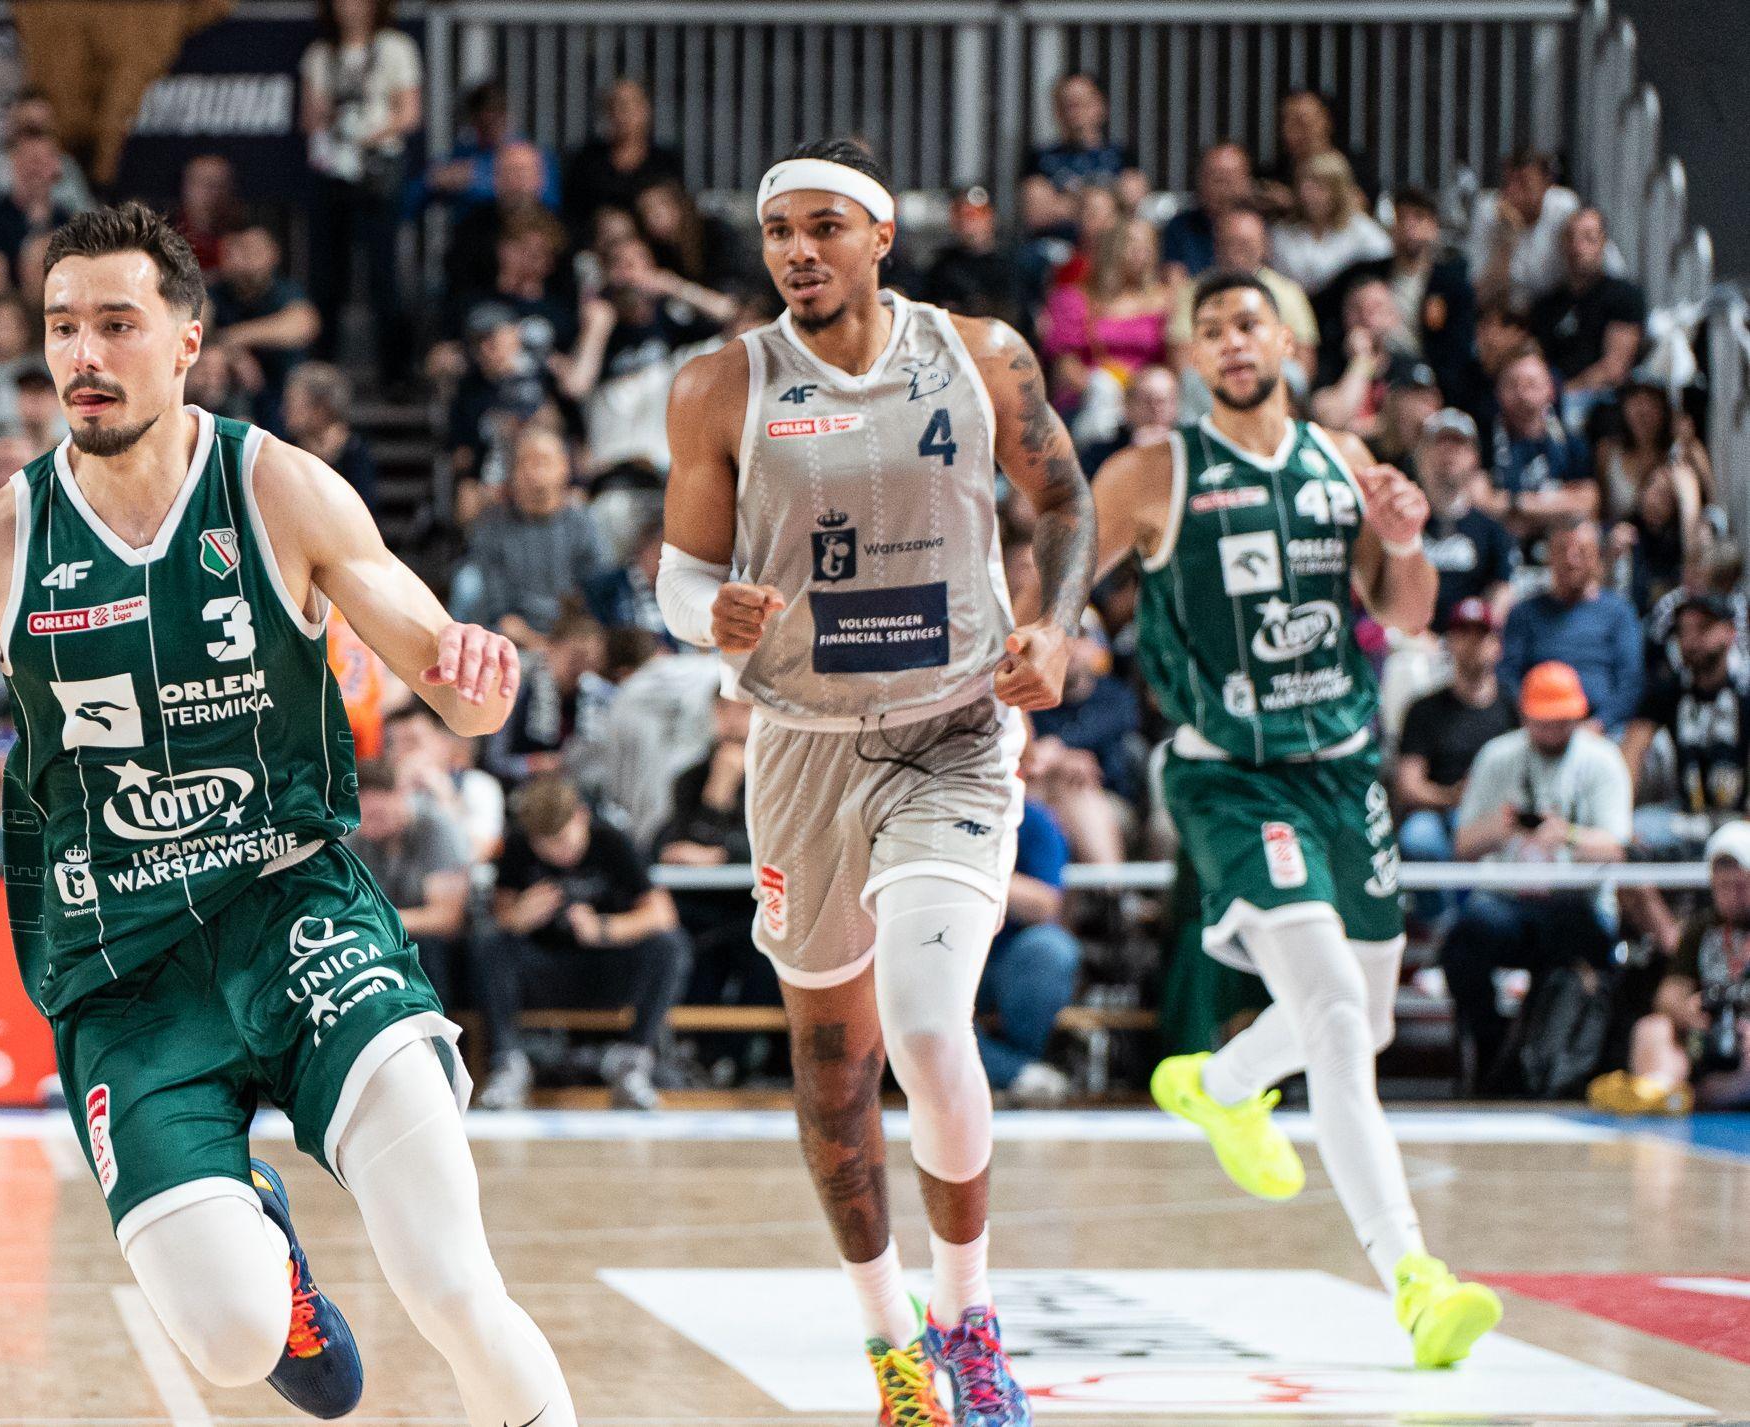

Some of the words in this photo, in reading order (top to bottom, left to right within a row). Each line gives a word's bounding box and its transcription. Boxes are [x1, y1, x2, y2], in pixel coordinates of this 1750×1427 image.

[778, 384, 818, 404] 4F
[771, 422, 812, 435] ORLEN
[918, 407, 958, 467] 4
[1294, 479, 1360, 527] 42
[863, 536, 945, 556] Warszawa
[41, 560, 94, 590] 4F
[112, 599, 143, 613] Basket
[113, 612, 132, 623] Liga
[33, 613, 85, 632] ORLEN
[202, 596, 256, 662] 3
[819, 633, 884, 647] FINANCIAL
[886, 625, 943, 643] SERVICES
[837, 614, 923, 631] VOLKSWAGEN
[158, 670, 266, 705] ORLEN
[161, 692, 275, 727] TERMIKA
[127, 778, 225, 827] LOTTO
[107, 831, 298, 894] WARSZAWSKIE
[286, 942, 383, 1004] UNIQA
